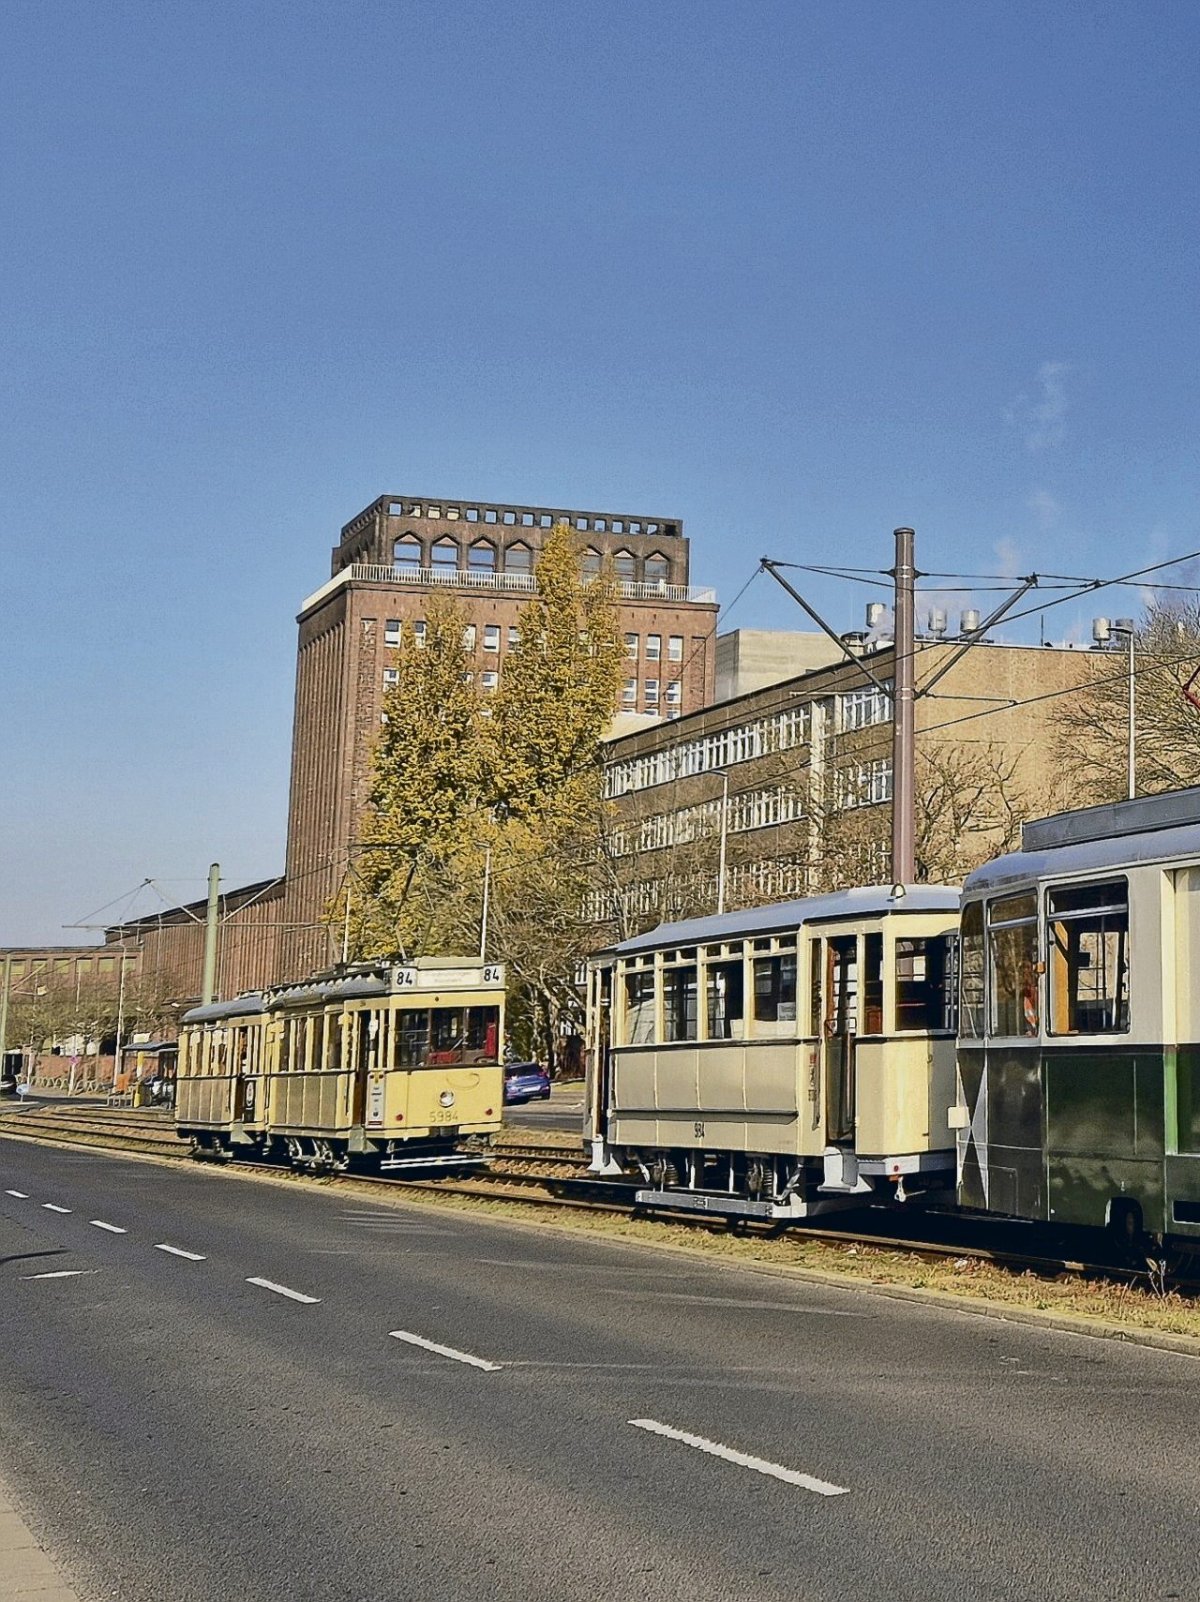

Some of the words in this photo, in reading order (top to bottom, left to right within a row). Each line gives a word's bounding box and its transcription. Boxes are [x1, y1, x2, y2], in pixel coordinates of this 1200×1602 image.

[396, 971, 413, 985] 84
[483, 968, 500, 982] 84
[429, 1111, 458, 1123] 5984
